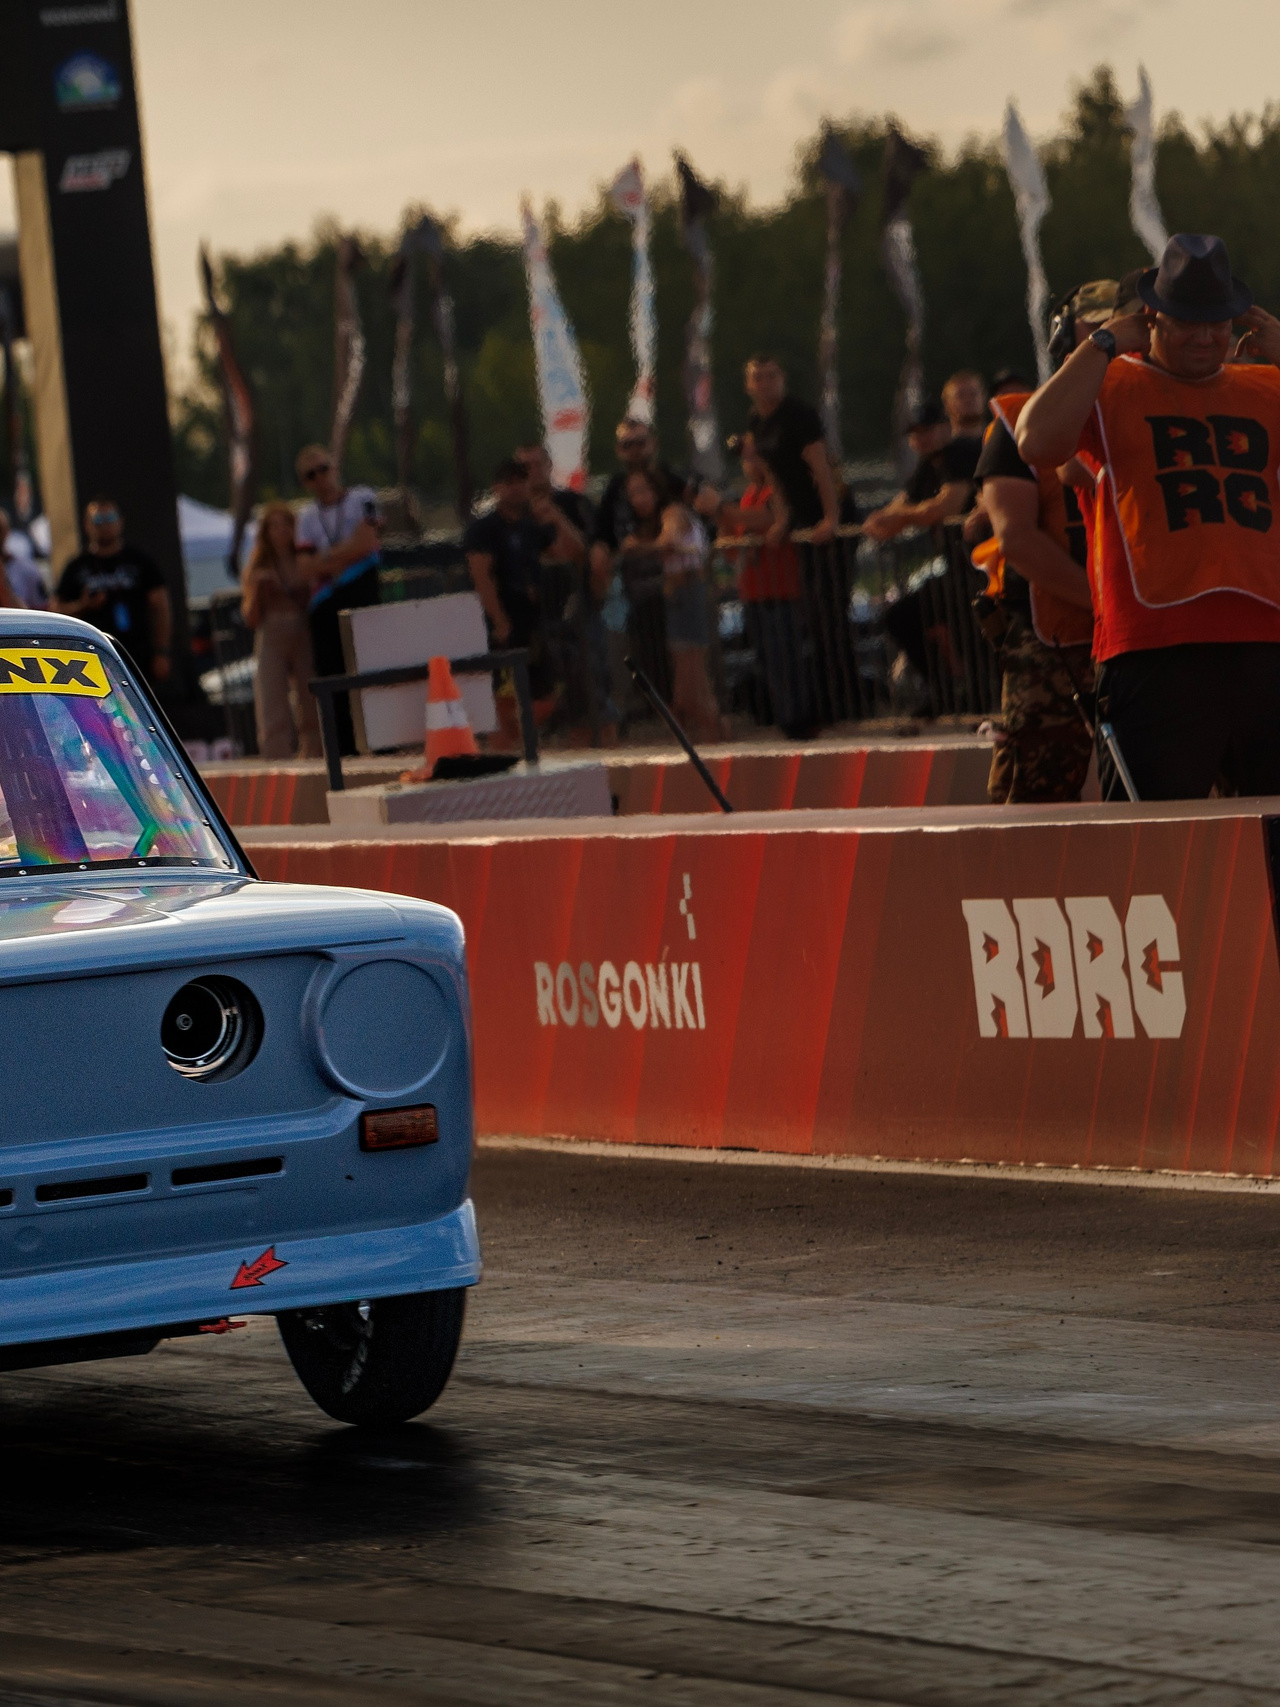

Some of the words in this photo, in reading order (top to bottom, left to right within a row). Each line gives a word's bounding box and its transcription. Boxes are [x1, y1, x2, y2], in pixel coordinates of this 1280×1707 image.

[1144, 414, 1269, 473] RD
[1155, 468, 1273, 533] RC
[533, 960, 706, 1030] ROSGONKI
[961, 893, 1187, 1039] RDRC
